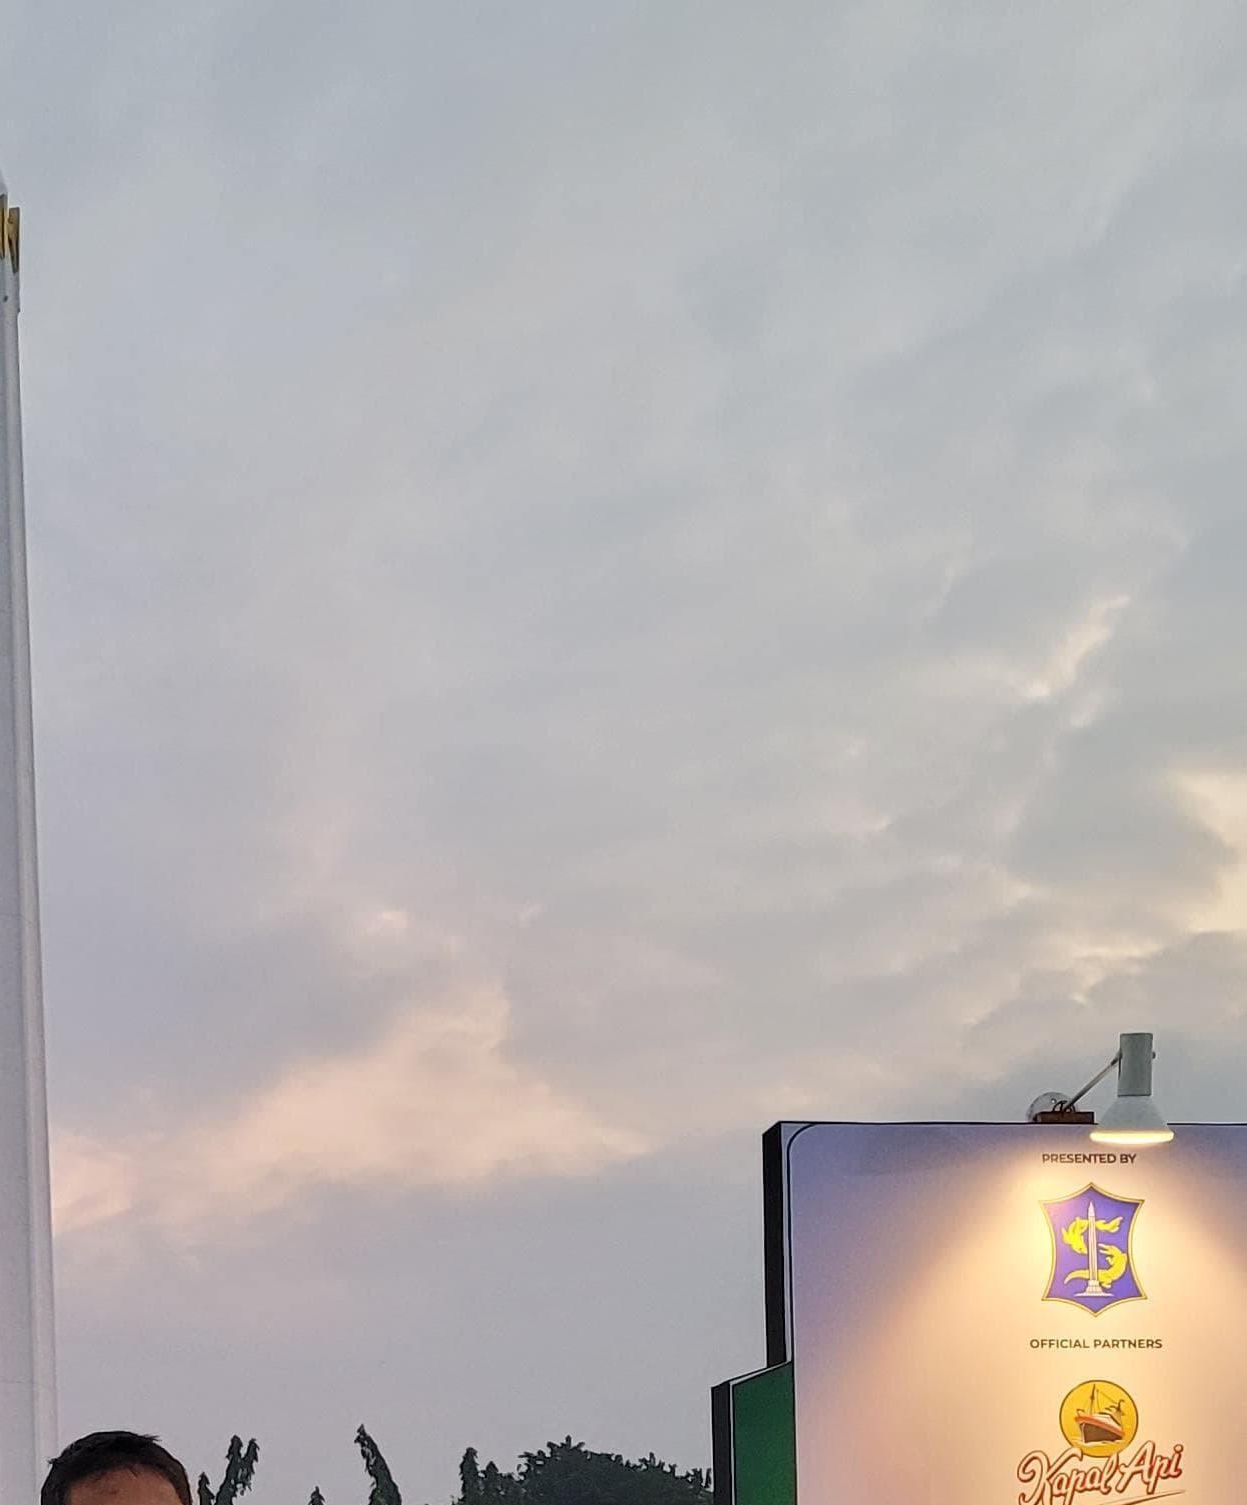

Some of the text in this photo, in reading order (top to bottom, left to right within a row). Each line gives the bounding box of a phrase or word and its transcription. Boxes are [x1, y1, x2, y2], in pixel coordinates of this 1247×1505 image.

[1042, 1153, 1137, 1164] PRESENTED BY
[1029, 1339, 1163, 1349] OFFICIAL PARTNERS
[1115, 1440, 1184, 1495] Api
